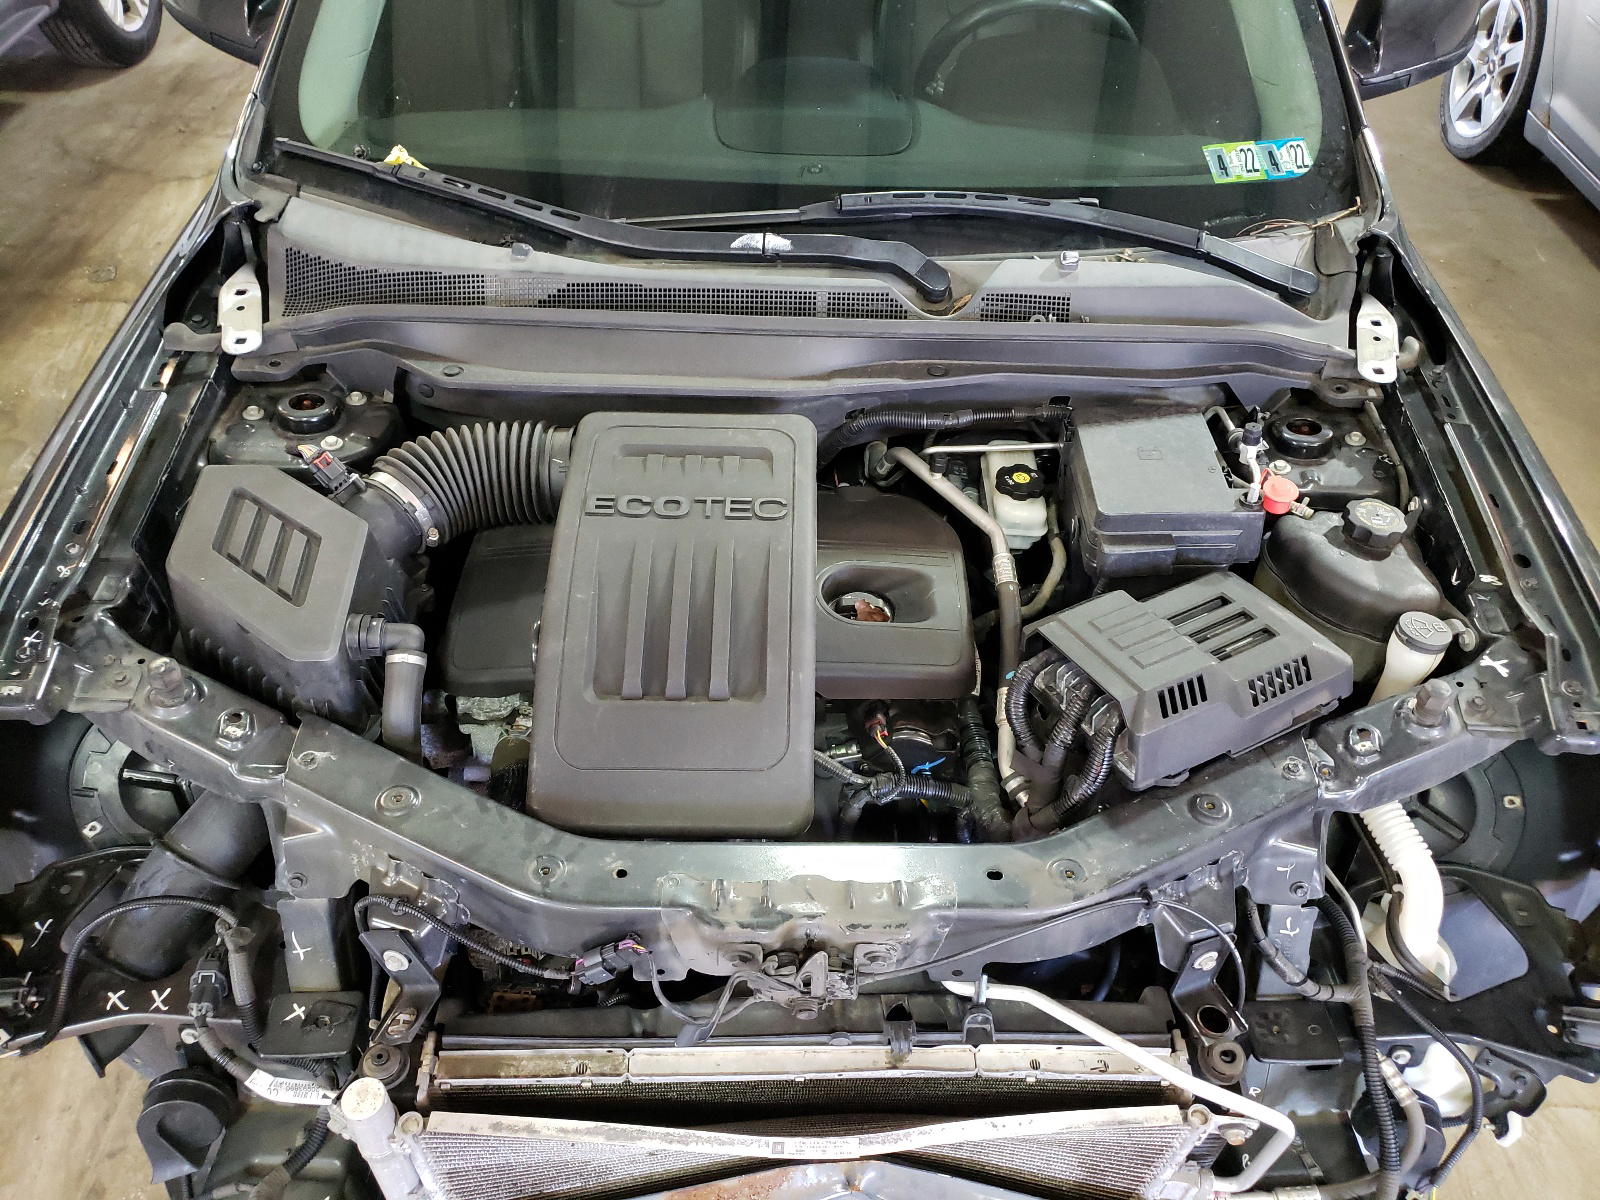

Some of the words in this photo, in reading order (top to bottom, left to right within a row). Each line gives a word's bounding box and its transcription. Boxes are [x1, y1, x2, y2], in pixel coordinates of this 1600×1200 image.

[1217, 154, 1229, 177] 4
[1239, 147, 1260, 173] 22
[1267, 150, 1281, 172] 4
[1289, 143, 1310, 169] 22
[585, 494, 788, 521] ECOTEC
